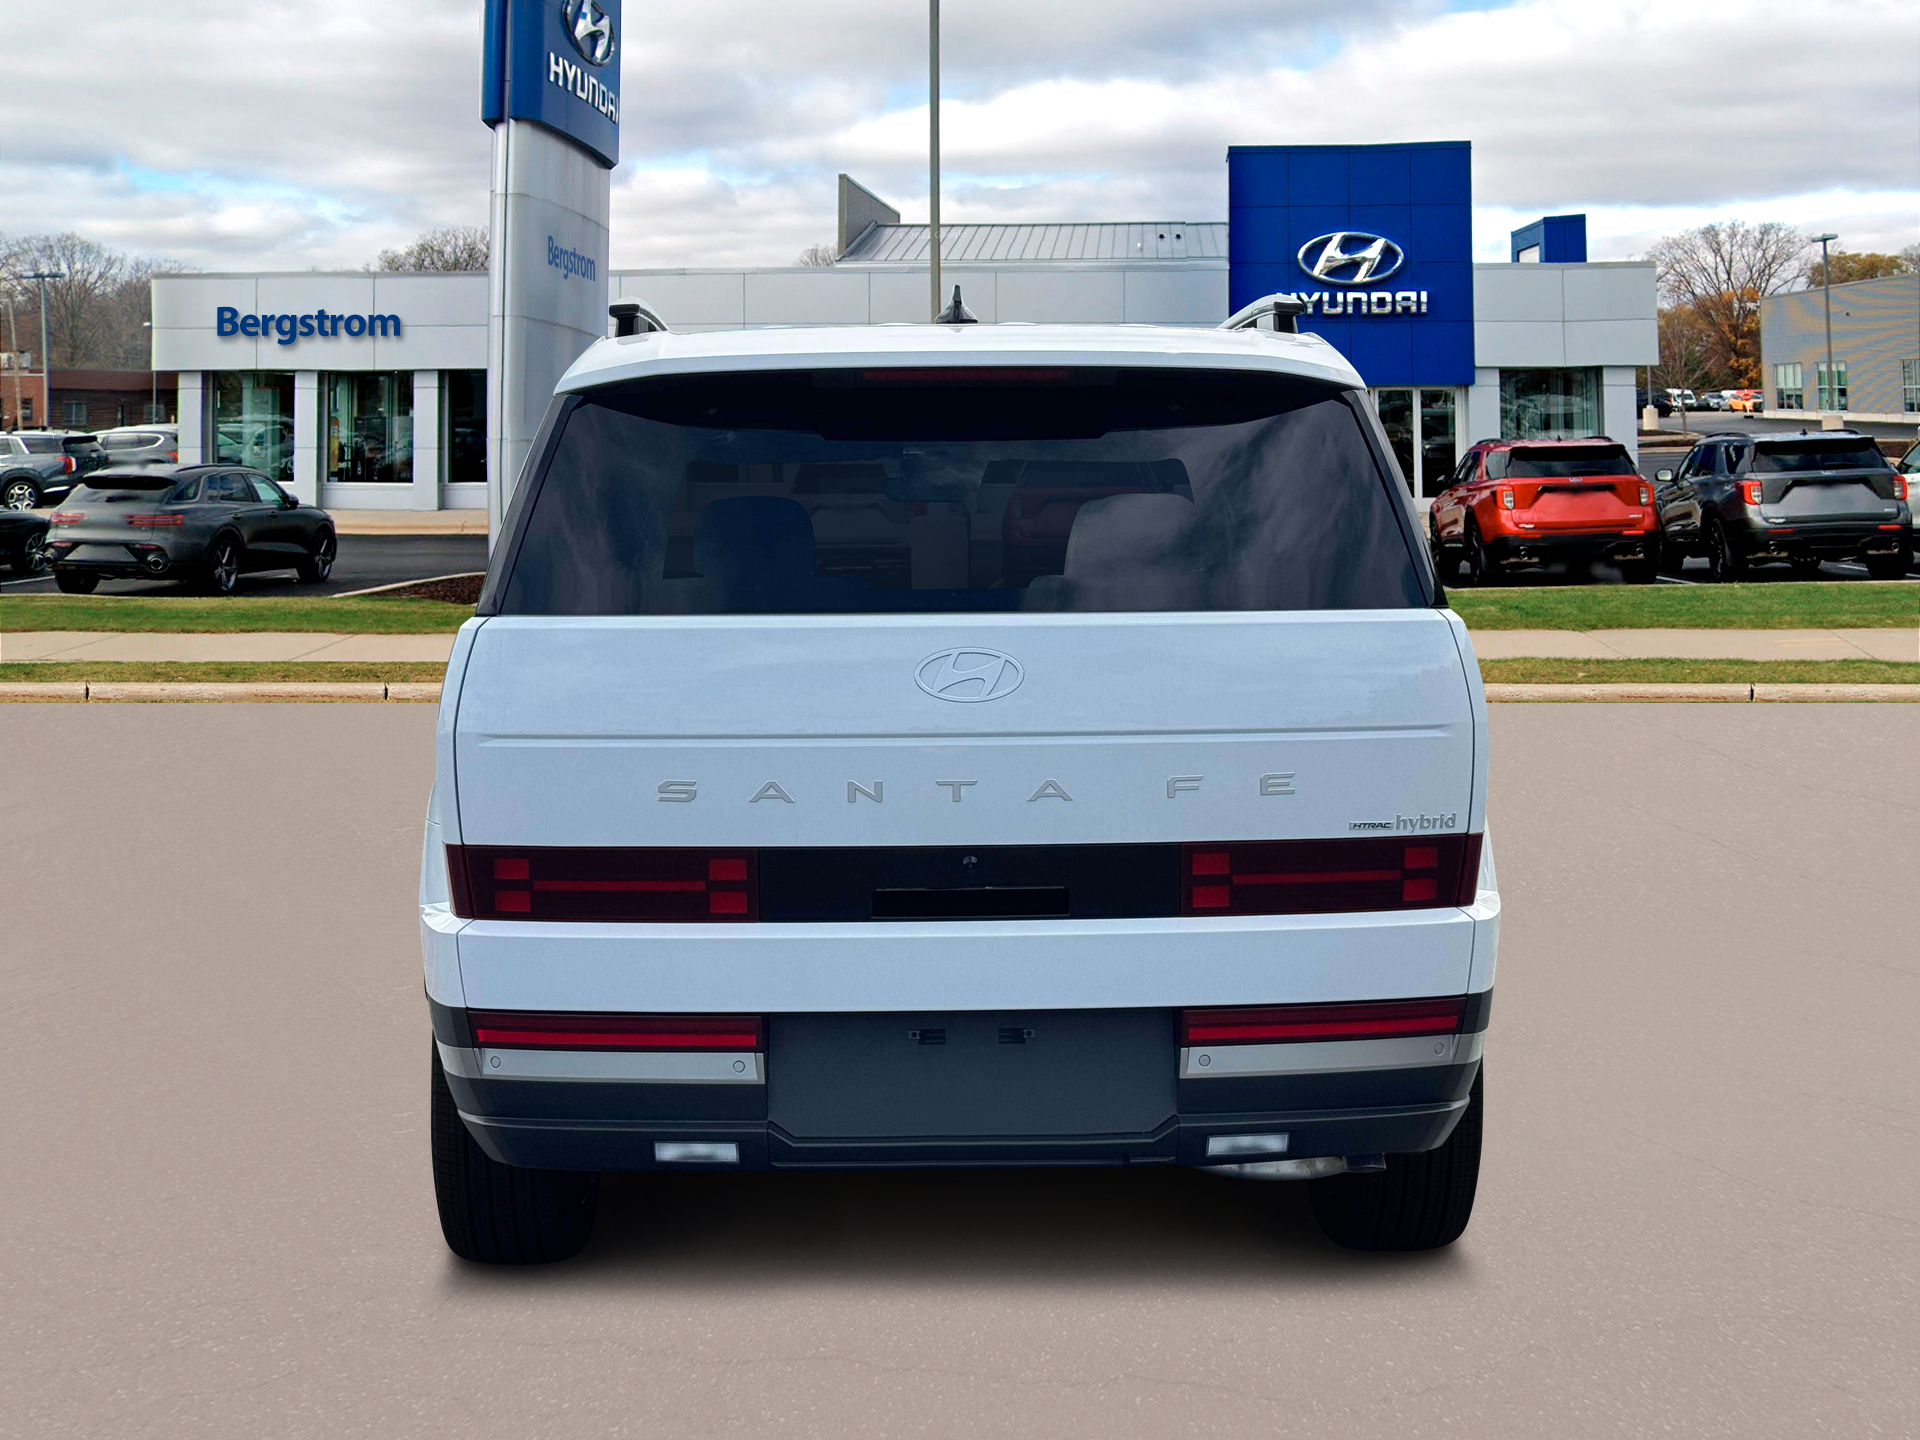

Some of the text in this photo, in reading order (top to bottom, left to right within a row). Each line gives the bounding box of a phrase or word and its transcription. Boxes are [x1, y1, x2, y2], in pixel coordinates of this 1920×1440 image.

[549, 52, 619, 124] HYUNDAI
[548, 235, 596, 282] Bergstrom
[1276, 291, 1428, 315] YUNDAI
[217, 306, 401, 346] Bergstrom
[657, 771, 1296, 803] SANTA FE
[1396, 812, 1457, 834] hybrid
